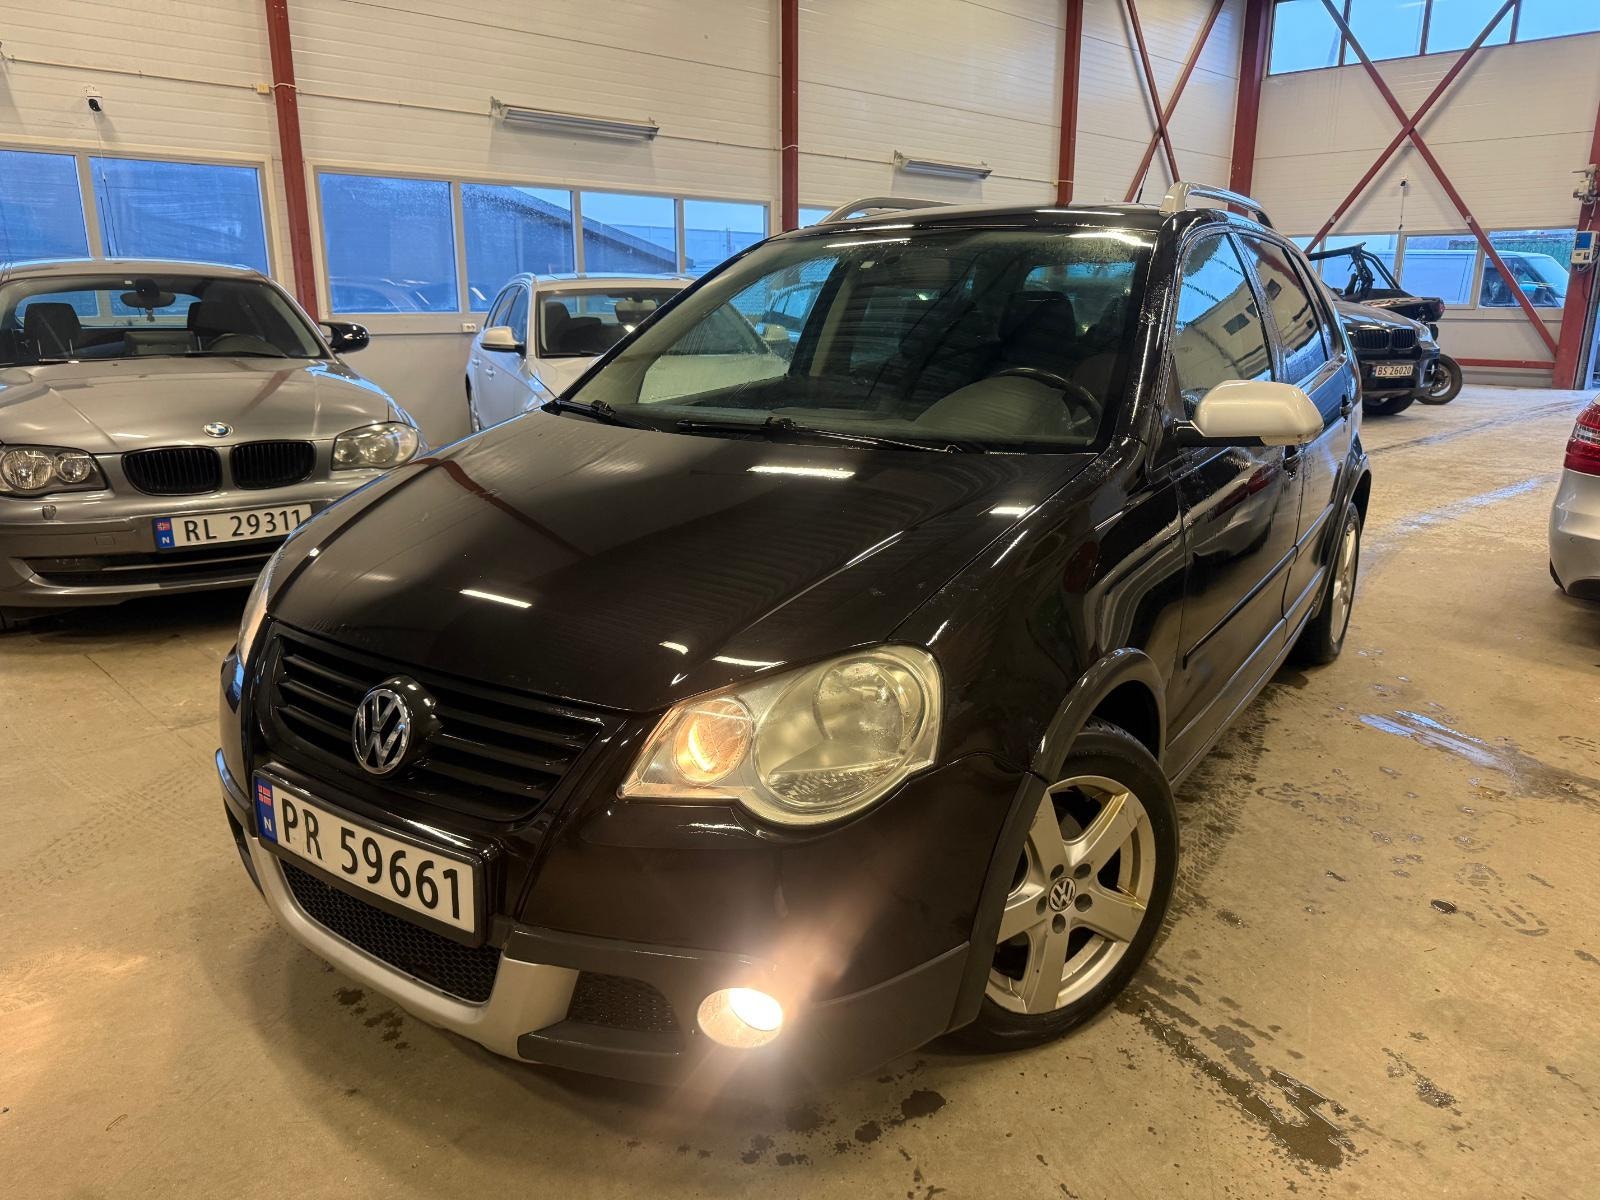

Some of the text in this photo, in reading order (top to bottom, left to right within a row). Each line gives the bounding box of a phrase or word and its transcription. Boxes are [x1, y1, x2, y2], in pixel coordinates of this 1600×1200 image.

[1390, 366, 1411, 375] 26020
[184, 509, 301, 542] RL 29311
[161, 536, 171, 544] N
[263, 817, 273, 832] N
[281, 797, 460, 920] PR 59661
